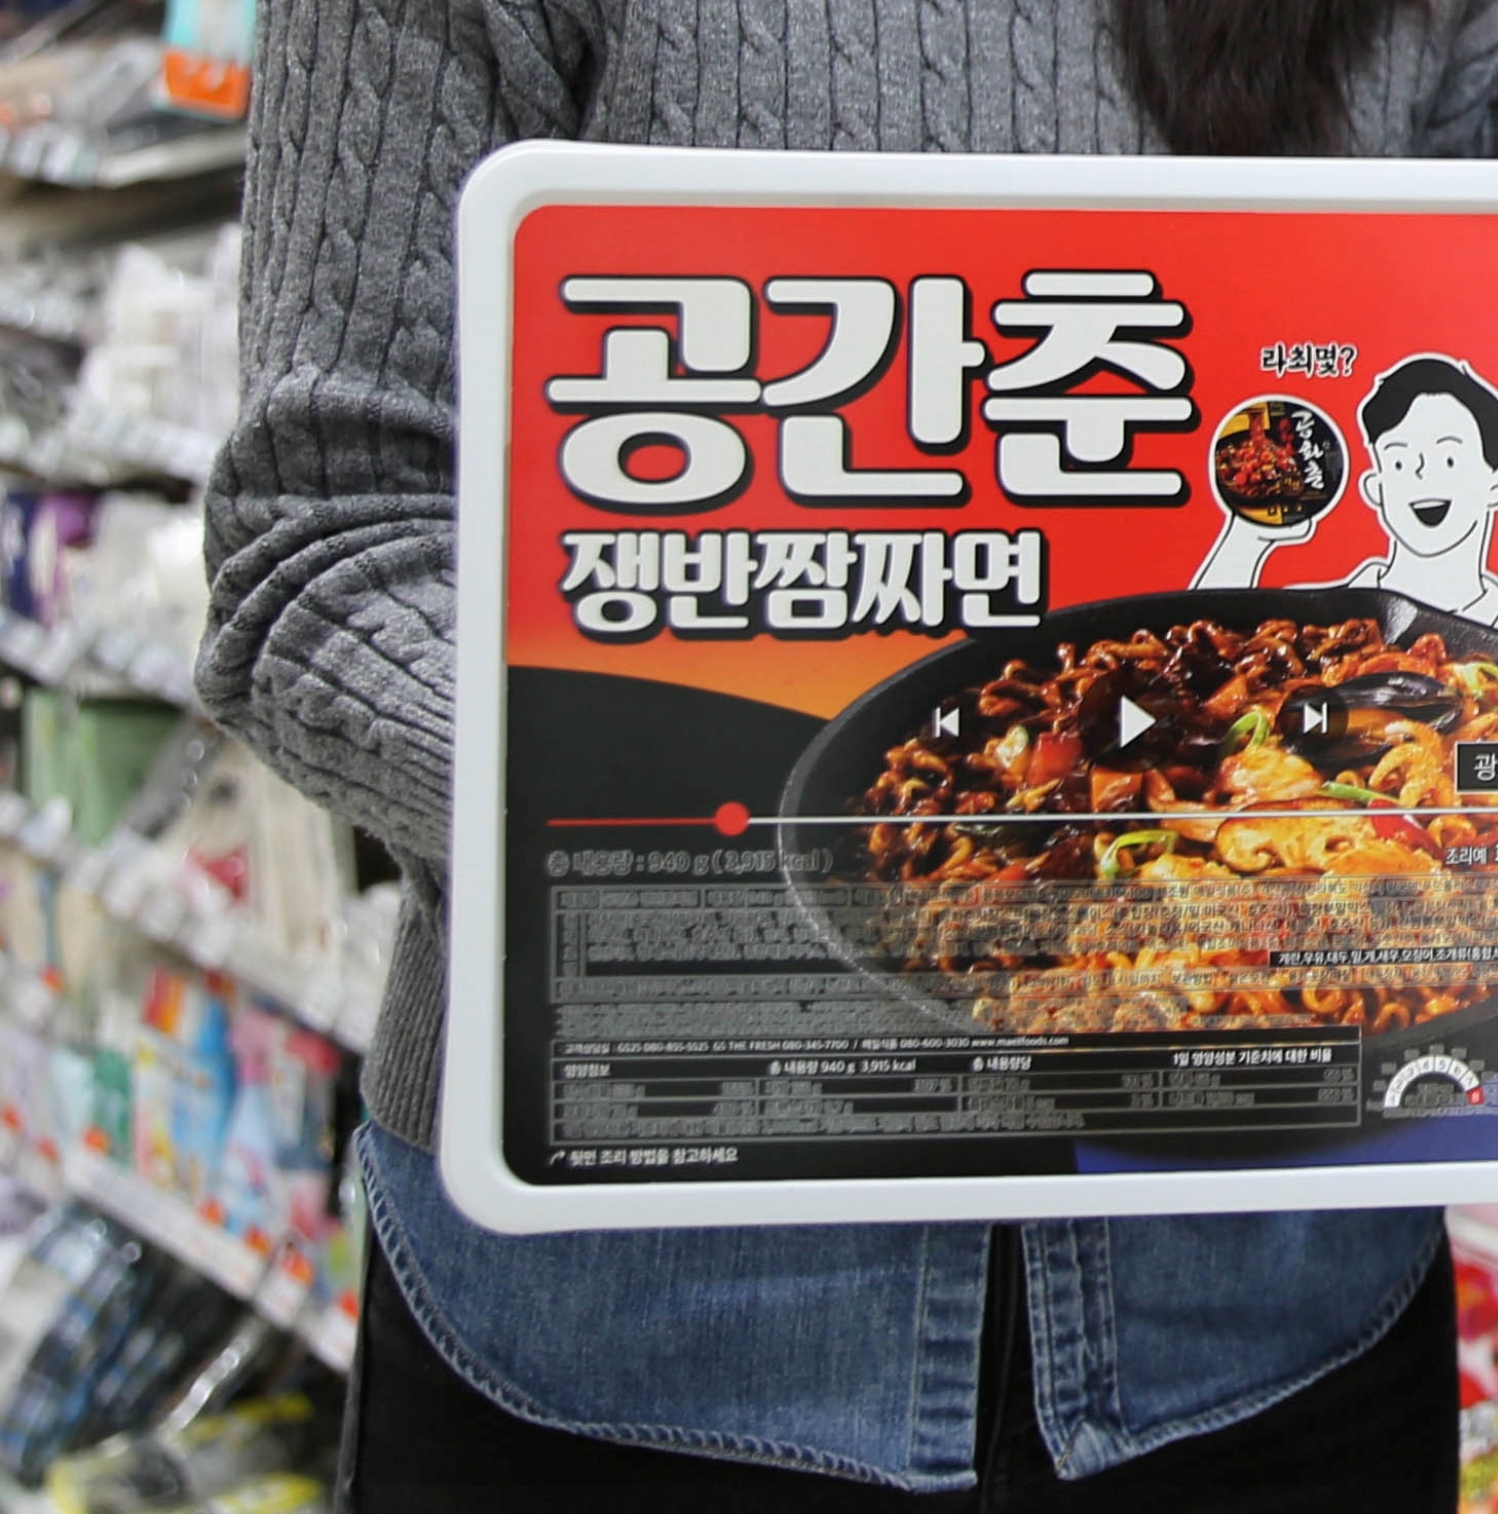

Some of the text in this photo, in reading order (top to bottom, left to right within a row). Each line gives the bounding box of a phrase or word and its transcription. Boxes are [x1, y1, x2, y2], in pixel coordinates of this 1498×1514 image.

[544, 269, 1193, 506] 공간춘
[560, 530, 1045, 636] 쟁반짬짜면
[821, 1059, 845, 1073] 940
[892, 1058, 917, 1072] kcal
[672, 1147, 739, 1165] 참고하세요
